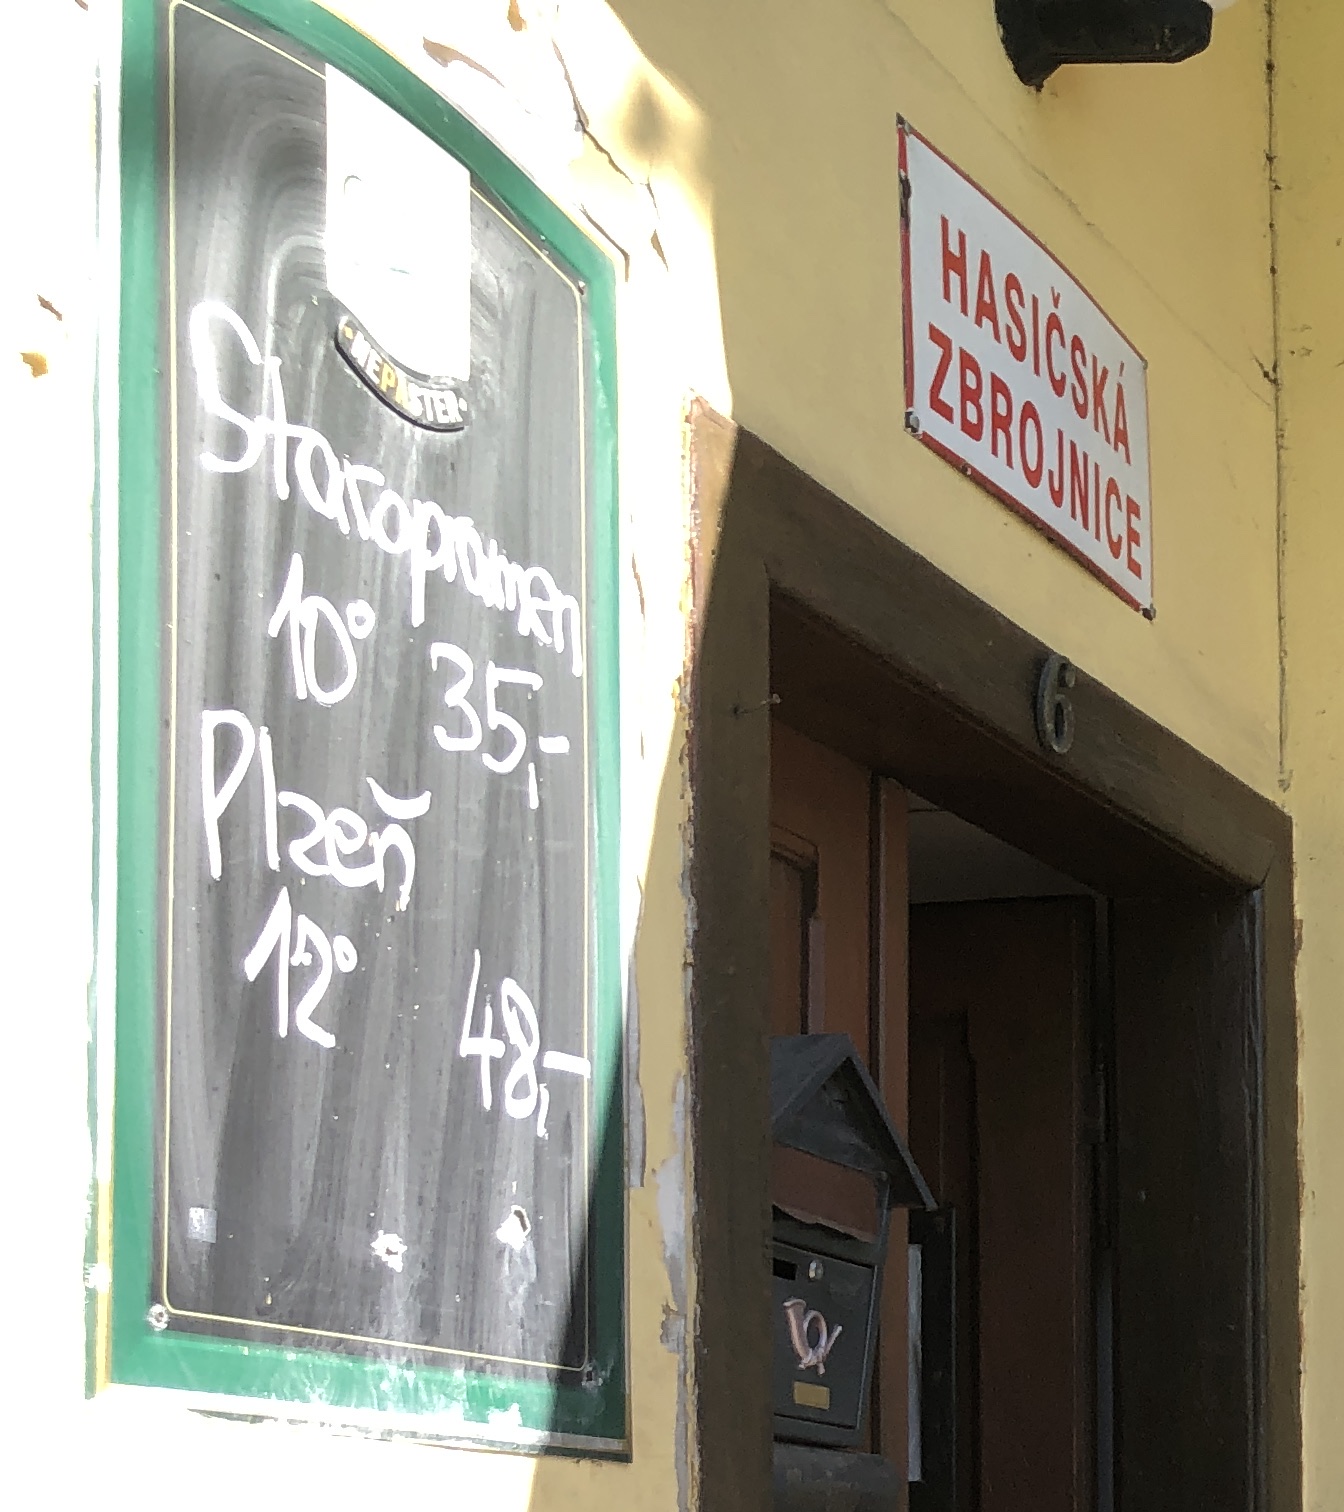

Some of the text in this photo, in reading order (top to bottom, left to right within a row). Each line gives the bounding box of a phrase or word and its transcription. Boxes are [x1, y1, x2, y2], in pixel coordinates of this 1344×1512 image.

[927, 321, 1143, 580] ZBROJNICE
[940, 213, 1132, 465] HASIČSKÁ
[188, 299, 584, 677] Staropramen
[201, 708, 432, 912] Plzeň
[1038, 652, 1076, 755] 6
